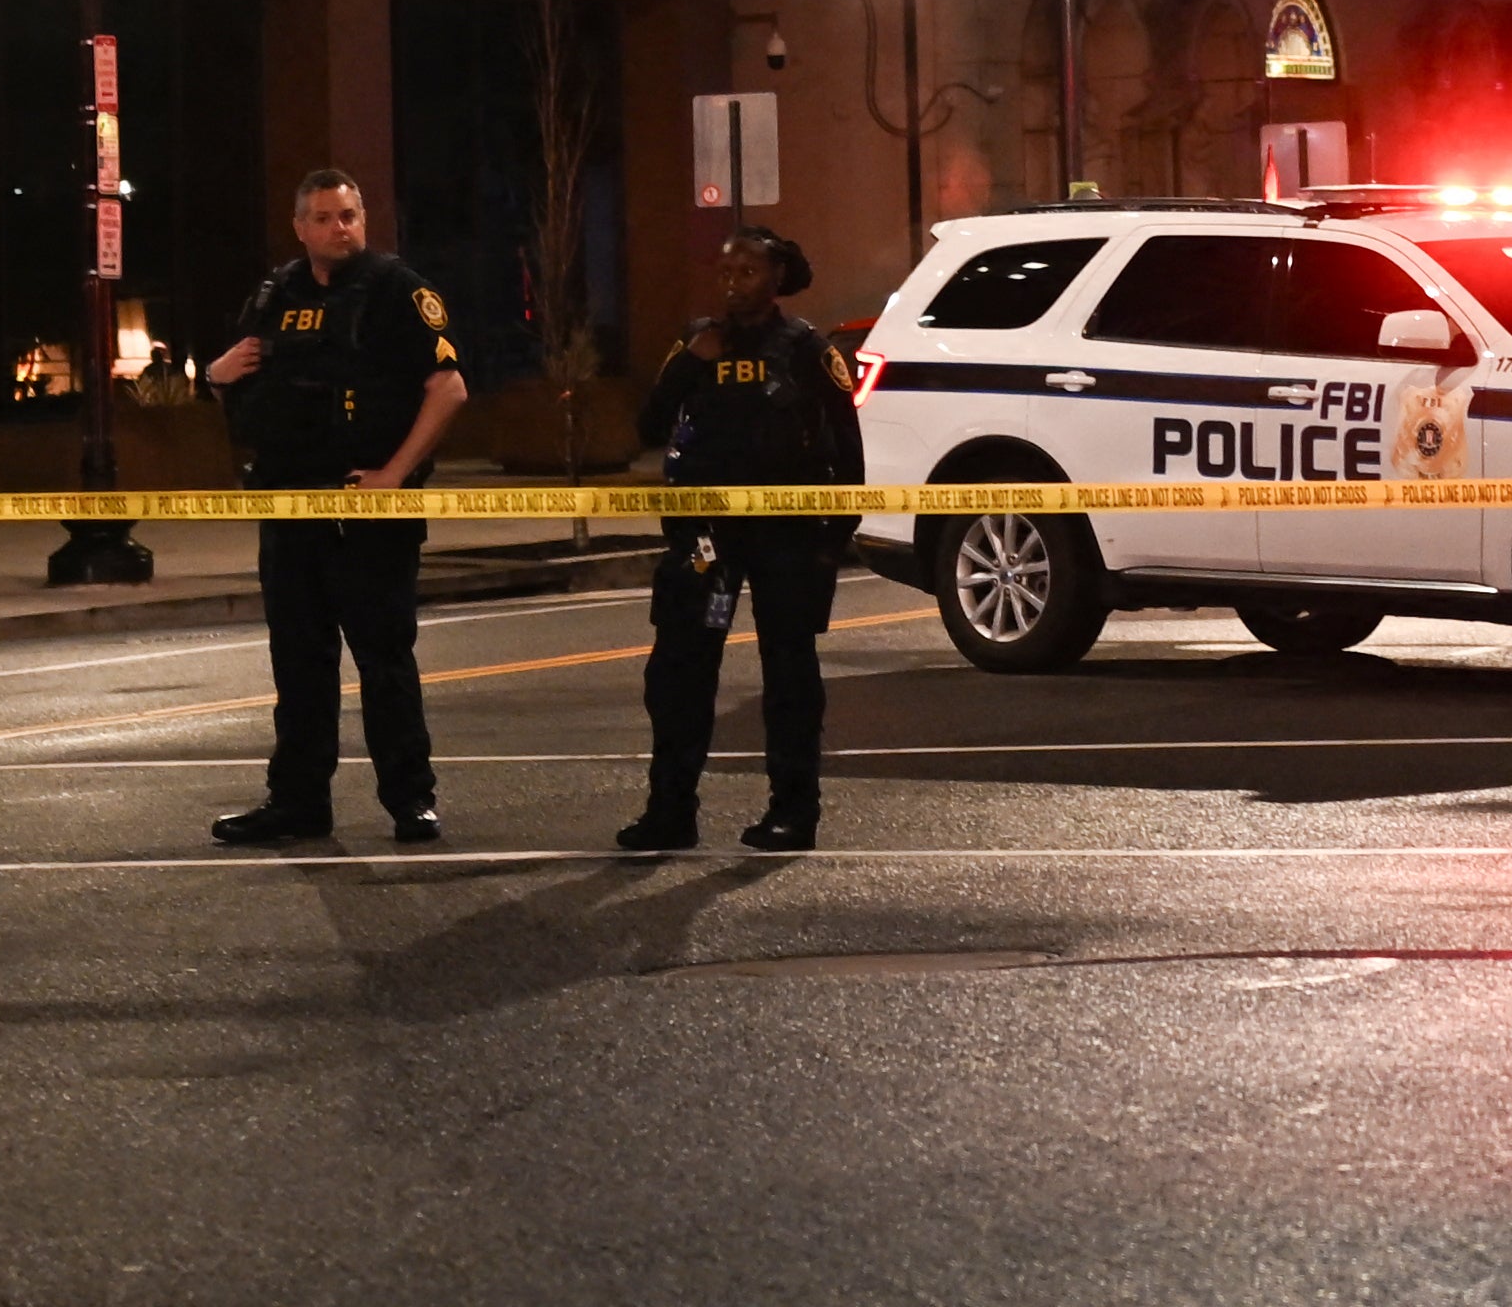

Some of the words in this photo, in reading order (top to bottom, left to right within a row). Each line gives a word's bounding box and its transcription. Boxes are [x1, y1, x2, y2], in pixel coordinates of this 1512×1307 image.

[279, 307, 325, 332] FBI
[716, 359, 767, 385] FBI
[1320, 382, 1386, 422] FBI
[1421, 397, 1442, 407] FBI
[1153, 417, 1381, 481] POLICE
[608, 492, 640, 511] POLICE
[642, 492, 662, 511] LINE
[664, 492, 677, 511] DO
[680, 492, 697, 511] NOT
[699, 491, 730, 511] CROSS
[763, 490, 795, 510] POLICE
[797, 490, 817, 510] LINE
[819, 490, 832, 510] DO
[835, 490, 852, 510] NOT
[855, 490, 886, 509] CROSS
[919, 490, 951, 509] POLICE
[953, 490, 974, 509] LINE
[976, 489, 989, 509] DO
[992, 489, 1009, 508] NOT
[1012, 489, 1043, 508] CROSS
[1078, 488, 1111, 508] POLICE
[1113, 488, 1134, 507] LINE
[1135, 488, 1149, 507] DO
[1152, 488, 1169, 507] NOT
[1172, 487, 1204, 507] CROSS
[1238, 486, 1272, 506] POLICE
[1274, 486, 1295, 505] LINE
[1297, 486, 1311, 505] DO
[1314, 486, 1332, 505] NOT
[1335, 485, 1367, 505] CROSS
[1402, 485, 1436, 504] POLICE
[1438, 485, 1460, 504] LINE
[1462, 485, 1476, 504] DO
[1478, 484, 1497, 504] NOT
